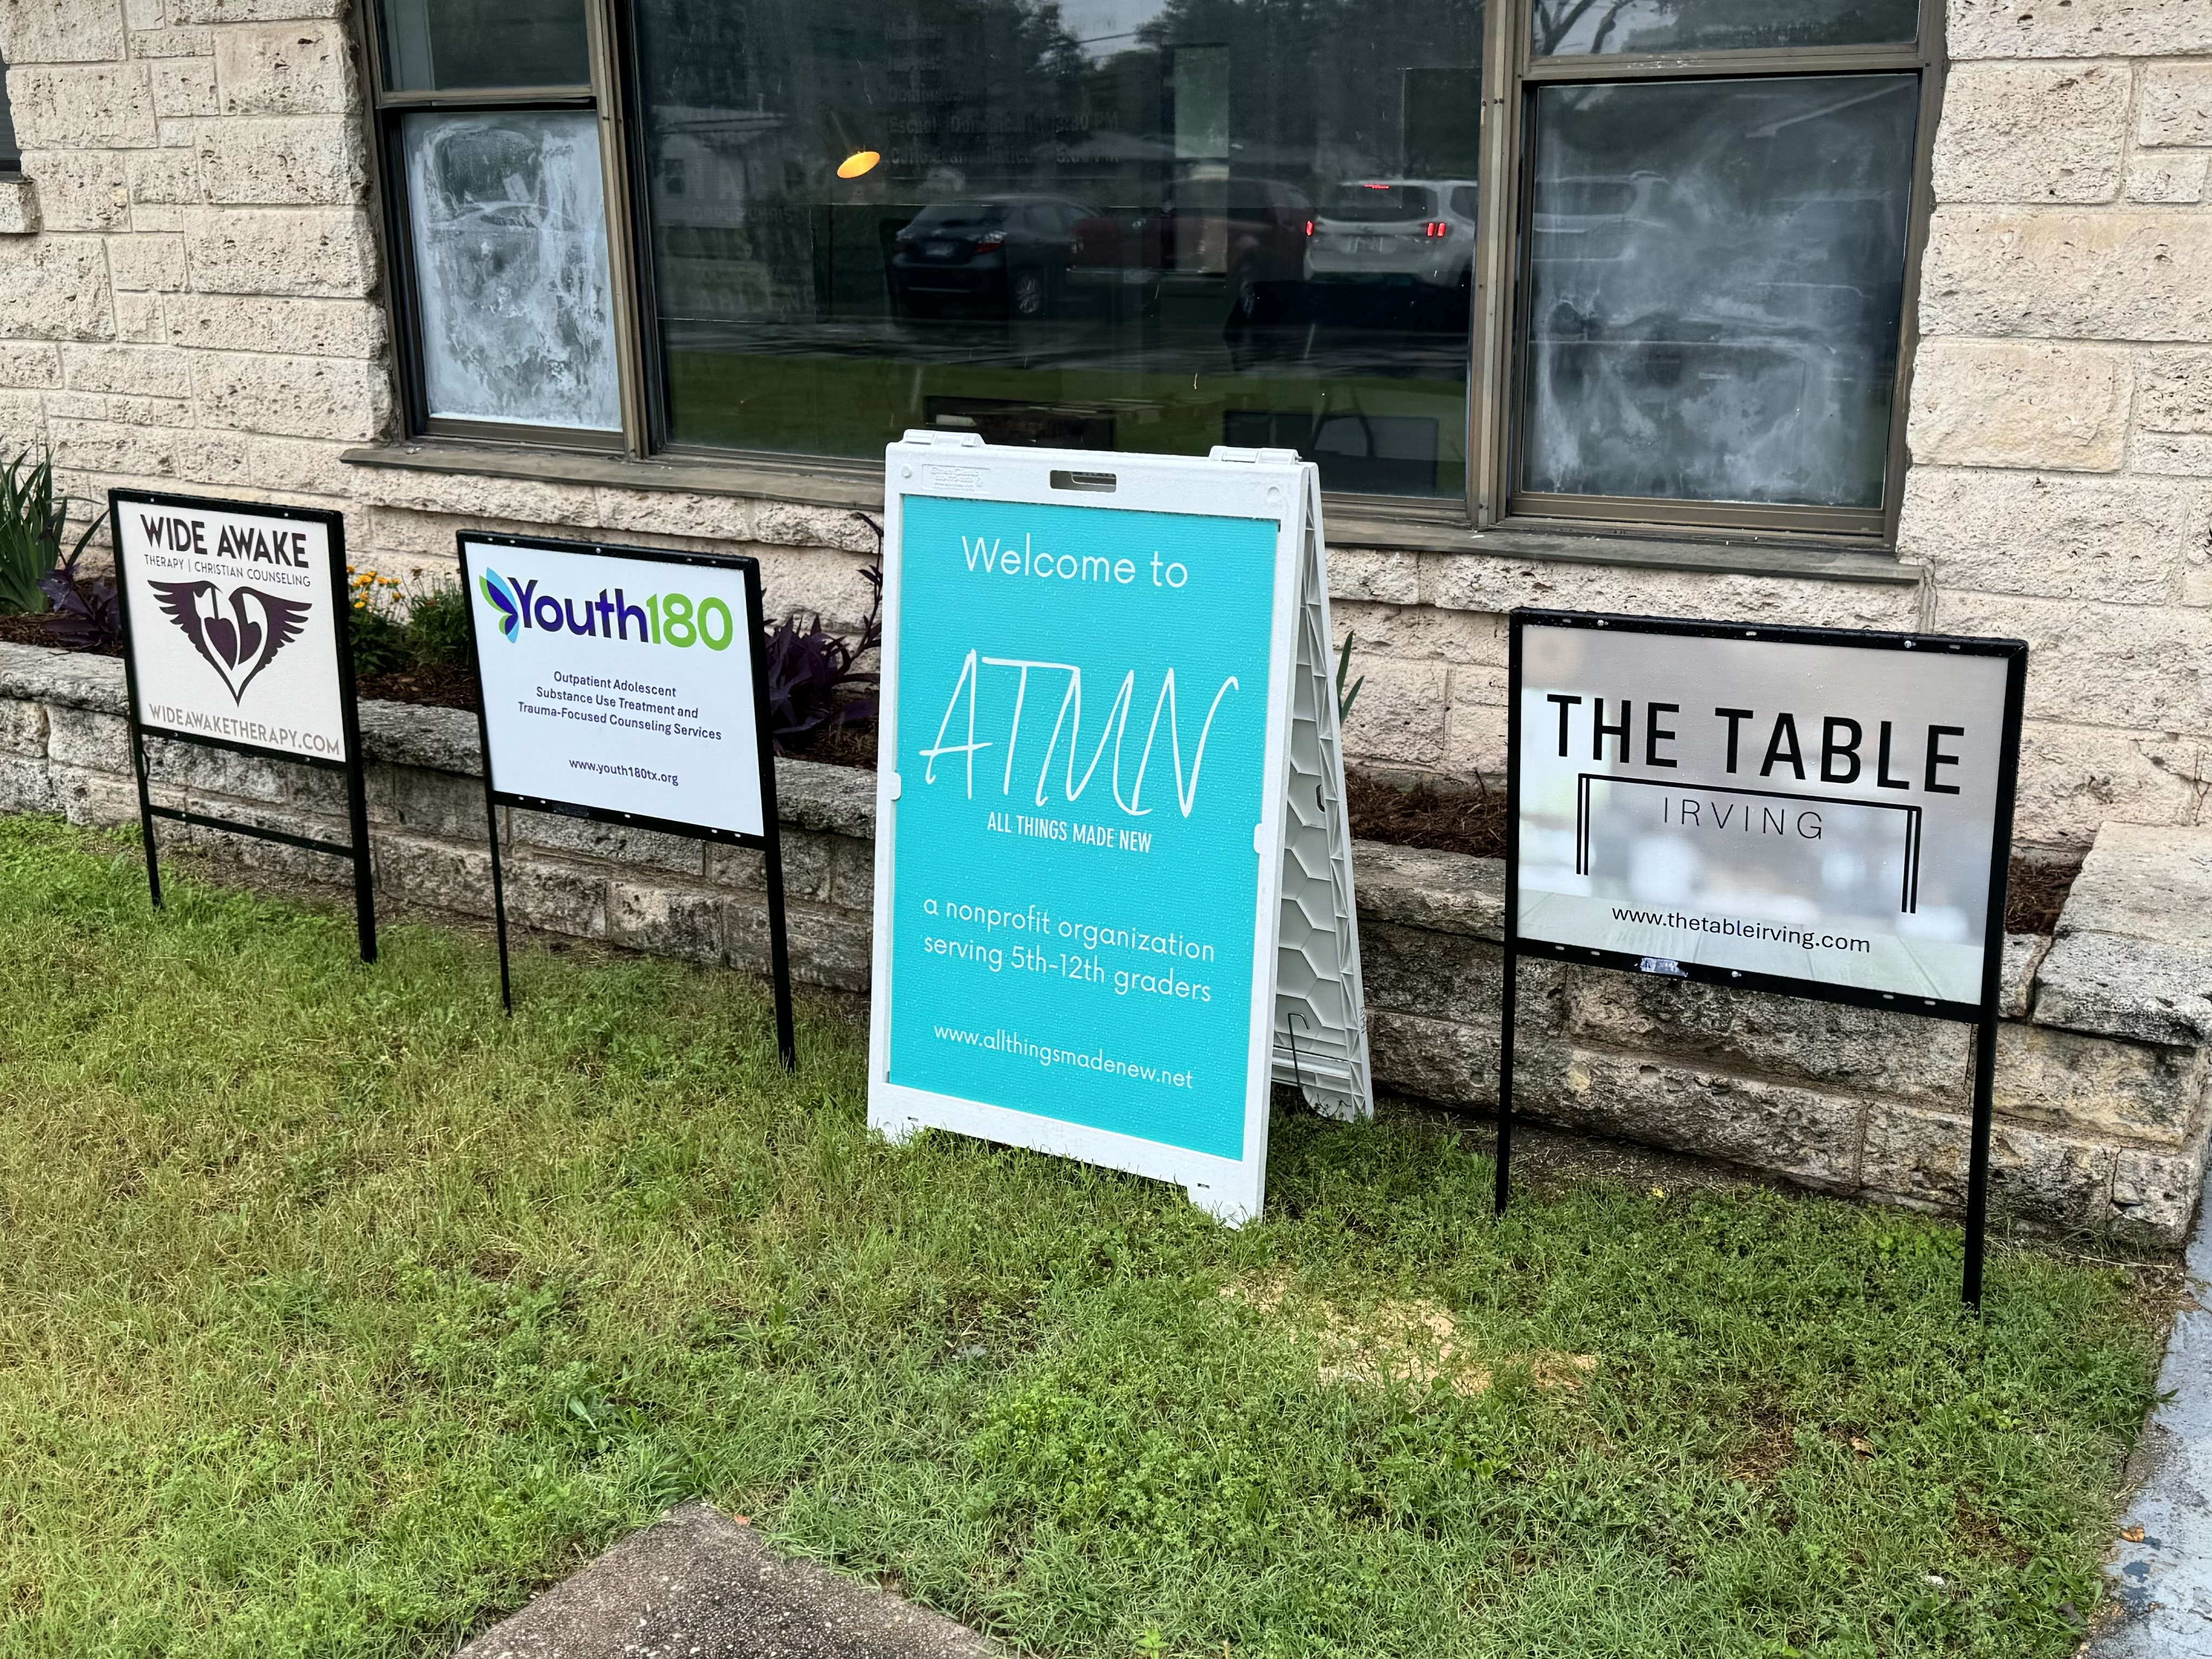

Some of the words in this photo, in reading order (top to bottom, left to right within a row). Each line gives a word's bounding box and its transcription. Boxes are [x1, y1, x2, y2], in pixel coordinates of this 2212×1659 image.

[139, 514, 208, 555] WIDE
[217, 524, 309, 569] AWAKE
[961, 532, 1136, 584] Welcome
[1150, 551, 1188, 588] to
[144, 554, 184, 570] THERAPY
[195, 561, 243, 578] CHRISTIAN
[247, 569, 311, 587] COUNSELING
[507, 576, 733, 651] Youth180
[536, 686, 592, 704] Substance
[596, 694, 616, 707] Use
[618, 697, 675, 716] Treatment
[677, 708, 698, 718] and
[554, 671, 611, 689] Outpatient
[613, 679, 676, 697] Adolescent
[149, 703, 340, 755] WIDEAWAKETHERAPY.COM
[518, 701, 607, 724] Trauma-Focused
[609, 714, 671, 736] Counseling
[674, 723, 722, 740] Services
[1547, 694, 1680, 768] THE
[1715, 707, 1964, 795] TABLE
[569, 759, 679, 787] www.youth180tx.org
[987, 811, 1012, 833] ALL
[1016, 815, 1068, 841] THINGS
[1072, 823, 1115, 848] MADE
[1119, 829, 1152, 853] NEW
[1664, 797, 1822, 840] IRVING
[923, 898, 938, 916] a
[947, 902, 1050, 935] nonprofit
[1058, 921, 1214, 962] organization
[1612, 908, 1870, 953] www.thetableirving.com
[924, 936, 1003, 972] serving
[1011, 945, 1104, 983] 5th-12th
[1114, 967, 1211, 1002] graders
[934, 1025, 1193, 1089] www.allthingsmadenew.net
